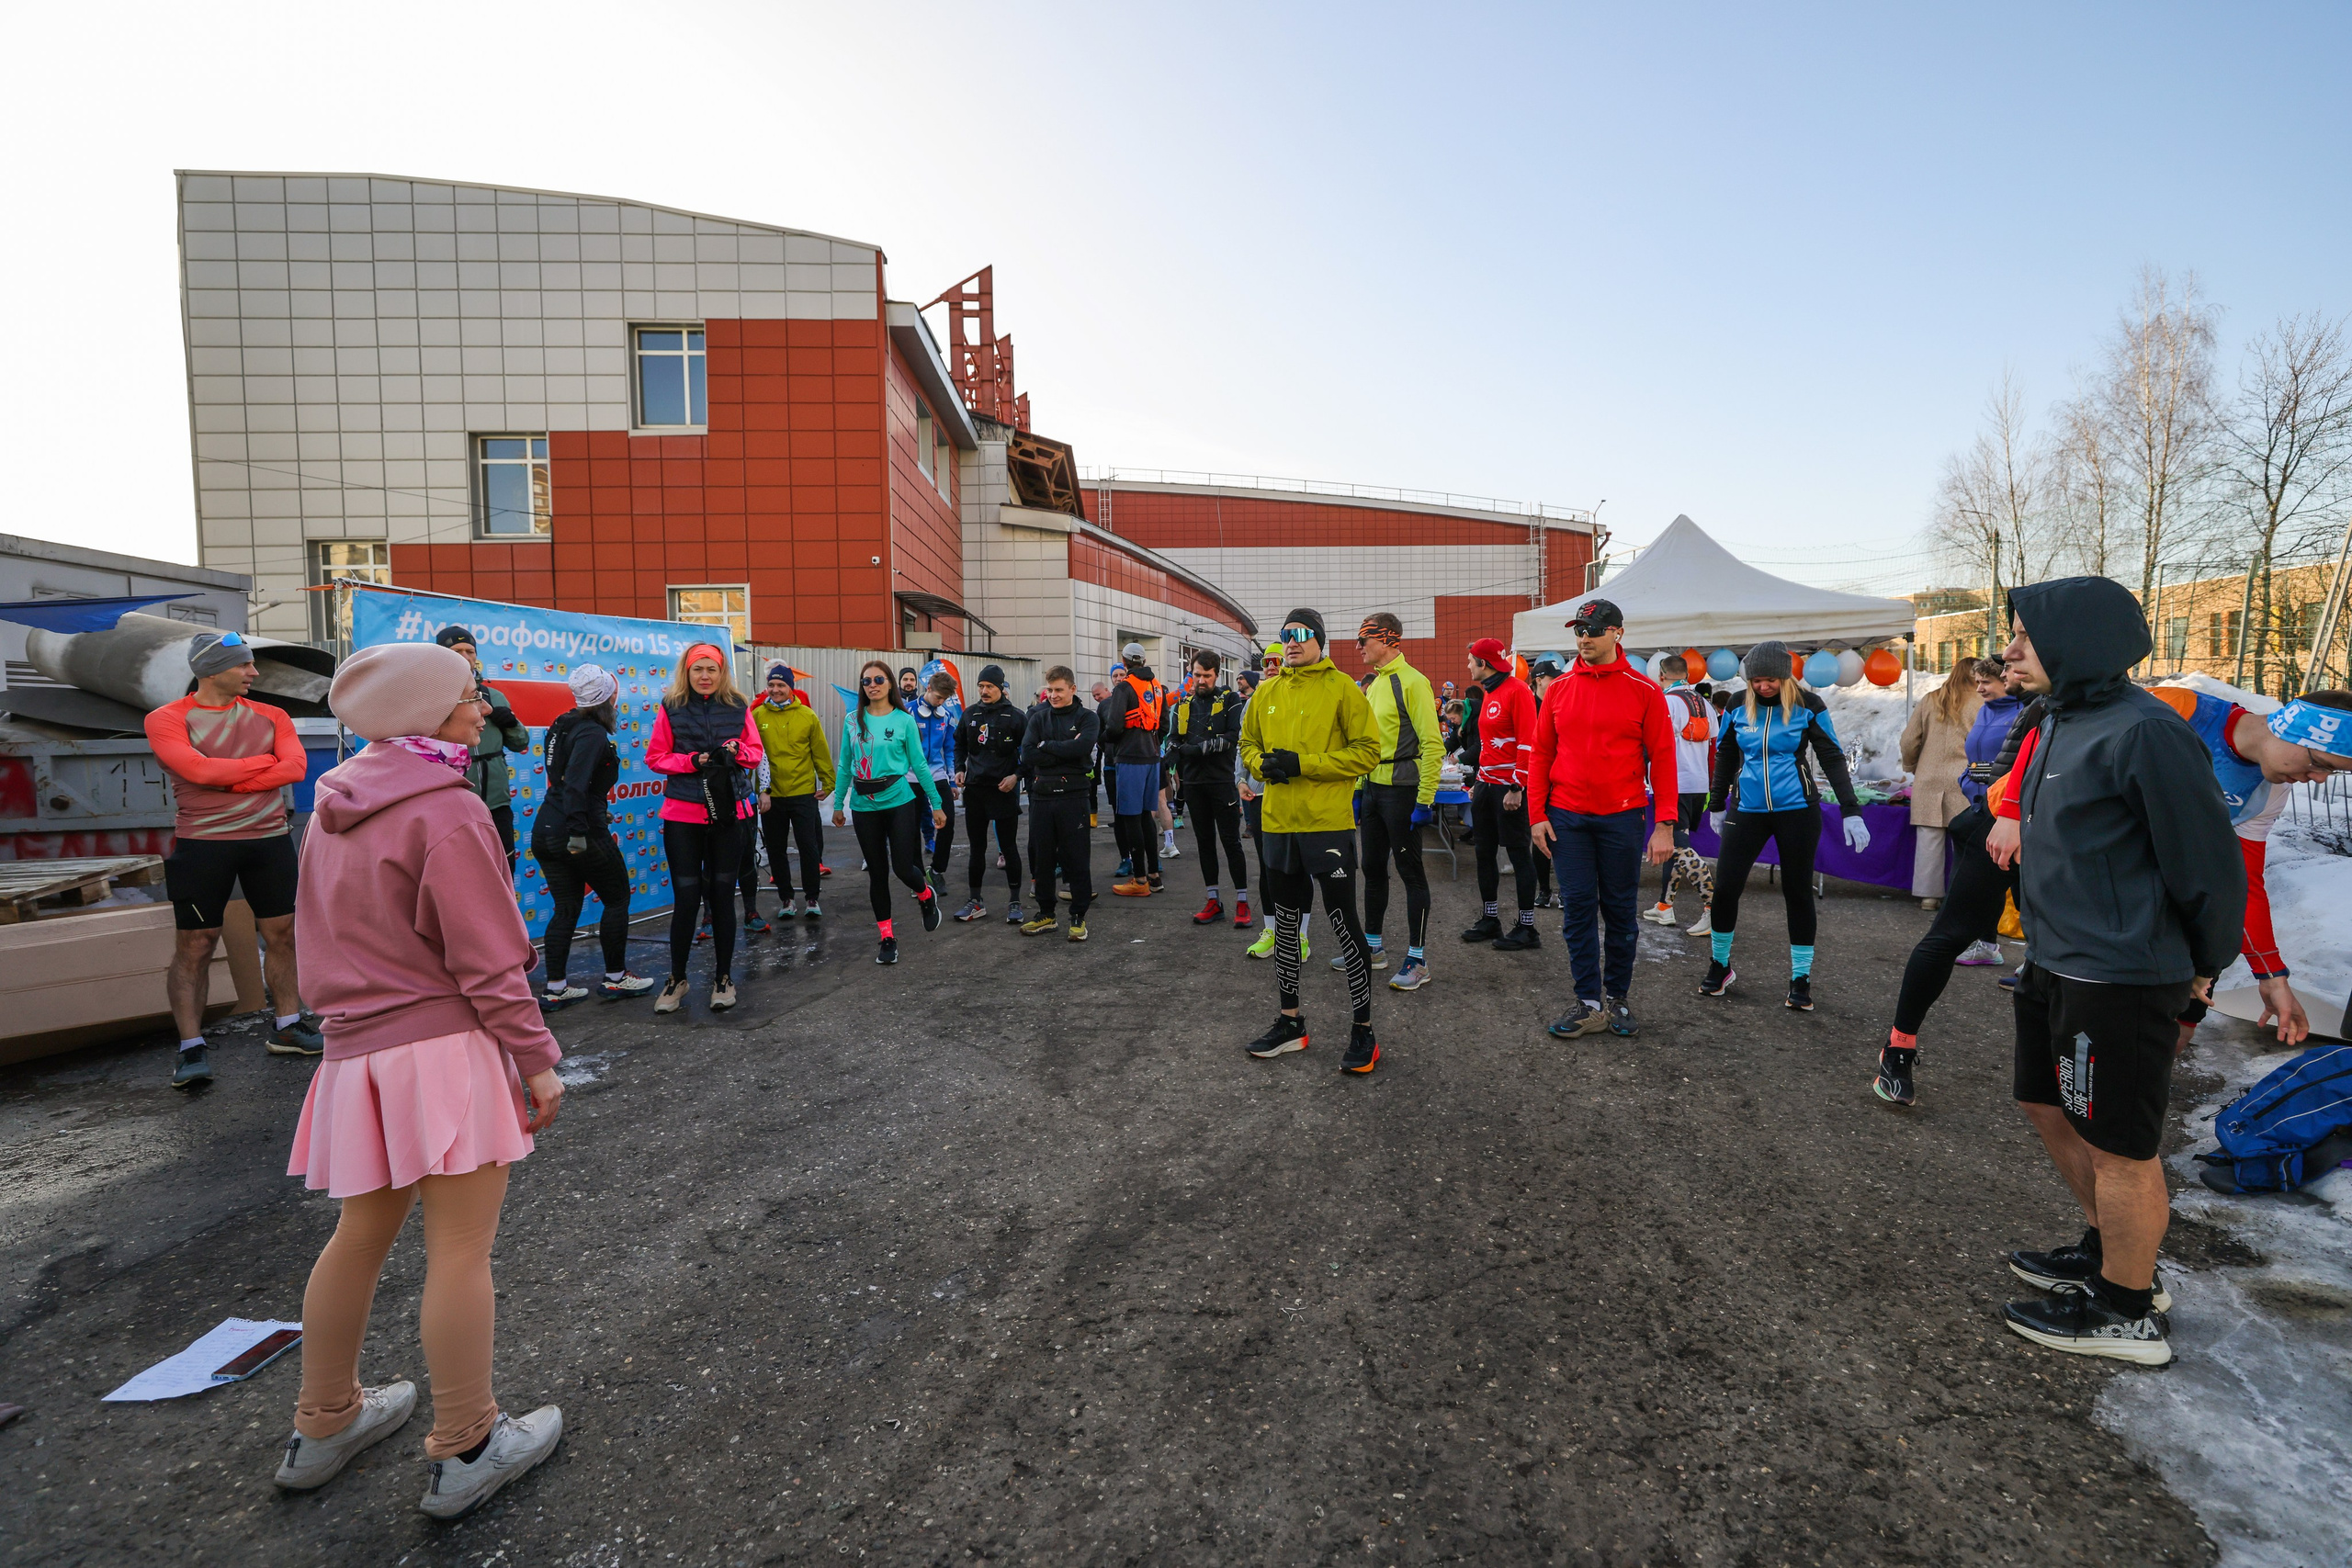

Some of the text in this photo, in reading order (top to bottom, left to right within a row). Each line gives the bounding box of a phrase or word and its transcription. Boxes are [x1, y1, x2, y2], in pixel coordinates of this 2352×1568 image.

[647, 633, 671, 656] 15
[1274, 902, 1300, 997] ADIDAS
[2059, 1055, 2074, 1111] SUPERIOR
[2074, 1089, 2088, 1118] SURF
[2091, 1317, 2159, 1340] HOKA
